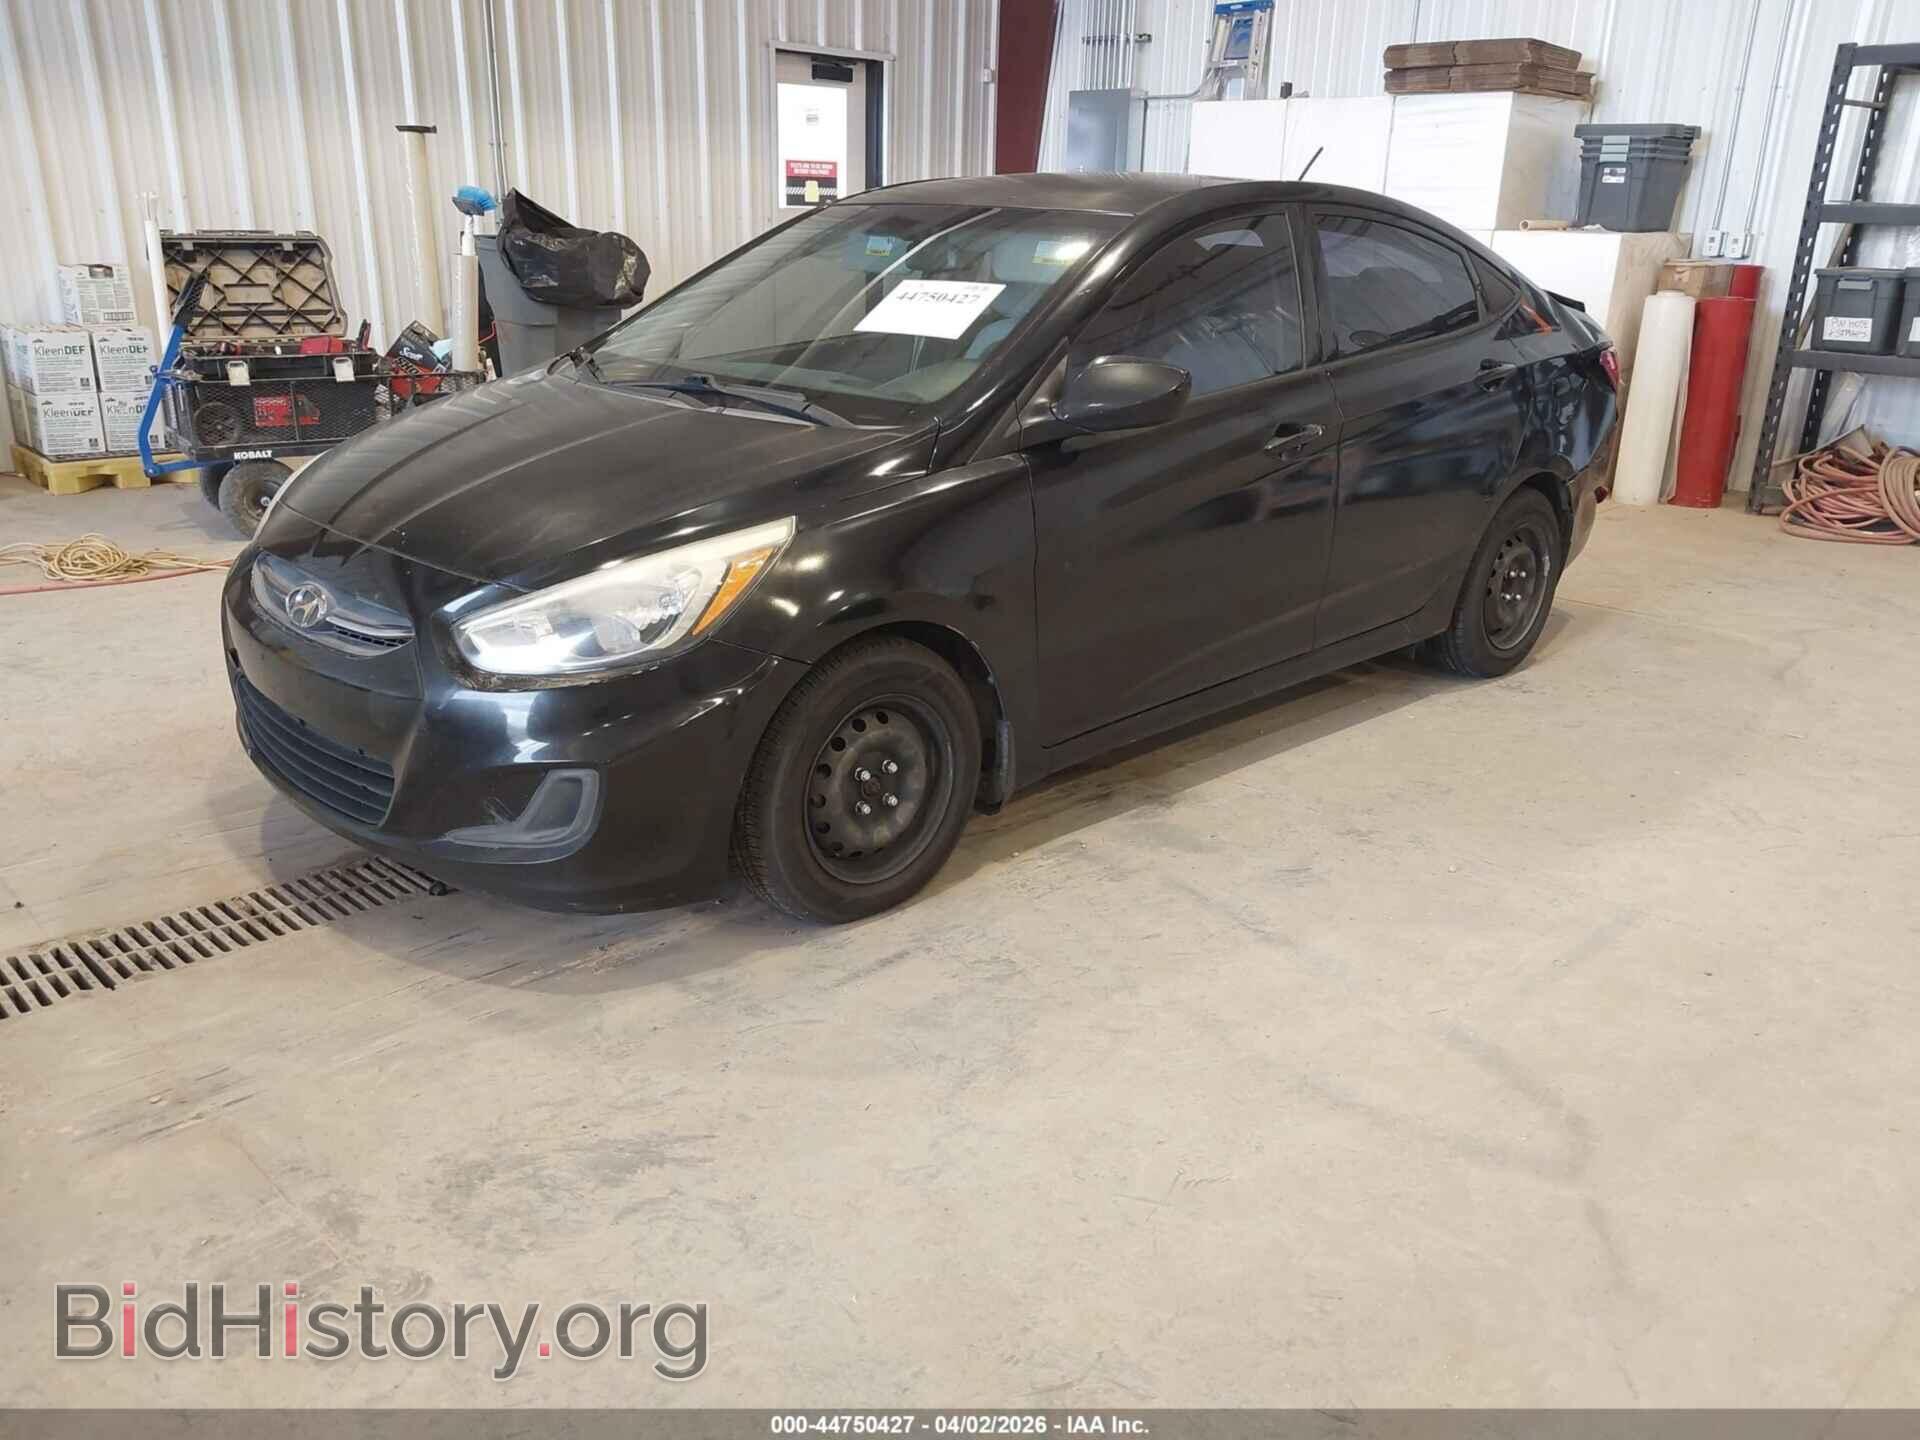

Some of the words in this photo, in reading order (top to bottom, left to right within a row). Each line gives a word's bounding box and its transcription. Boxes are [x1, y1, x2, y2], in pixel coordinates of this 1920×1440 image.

[896, 291, 980, 304] 44750427
[34, 344, 86, 356] KleenDEF
[100, 344, 149, 356] KleenDEF
[233, 450, 272, 460] KOBALT
